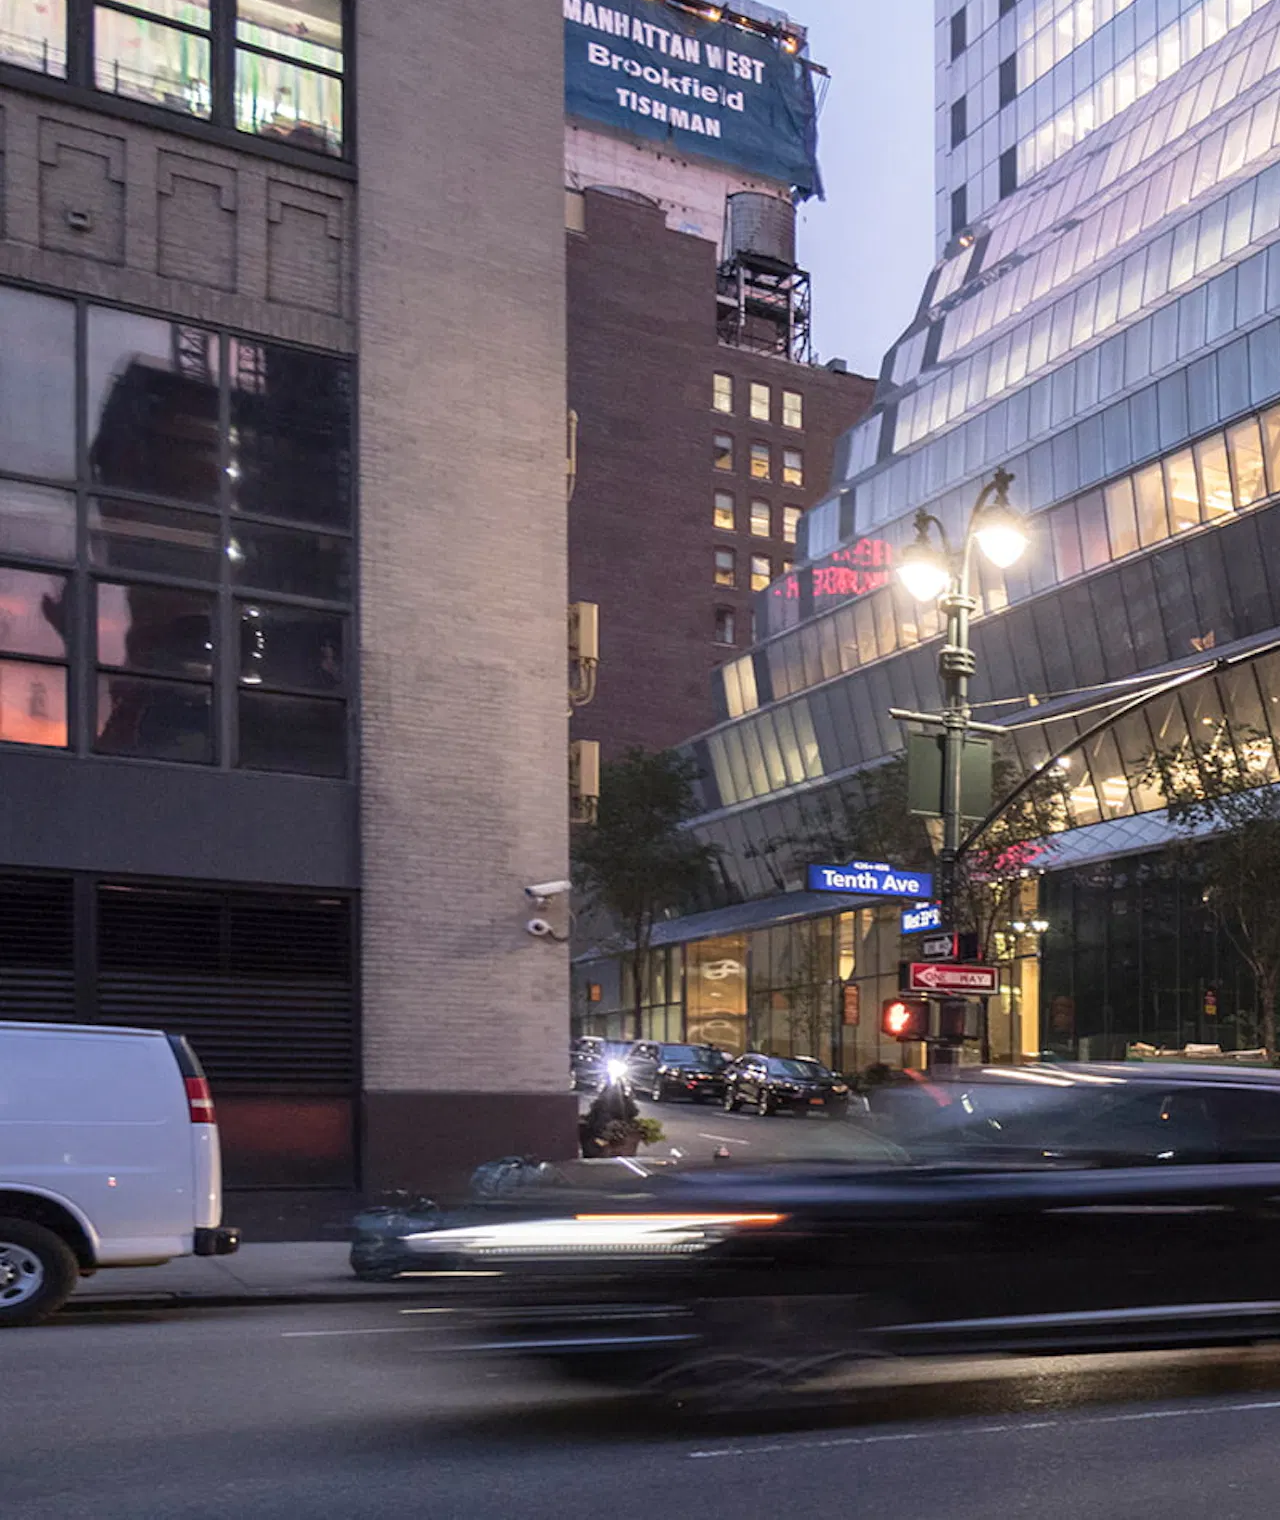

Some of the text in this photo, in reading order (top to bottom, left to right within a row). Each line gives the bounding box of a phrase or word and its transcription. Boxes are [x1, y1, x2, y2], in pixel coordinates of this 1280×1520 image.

[587, 42, 745, 112] Brookfield
[705, 45, 766, 84] WEST
[616, 88, 721, 138] TISHMAN
[822, 869, 920, 893] Tenth Ave
